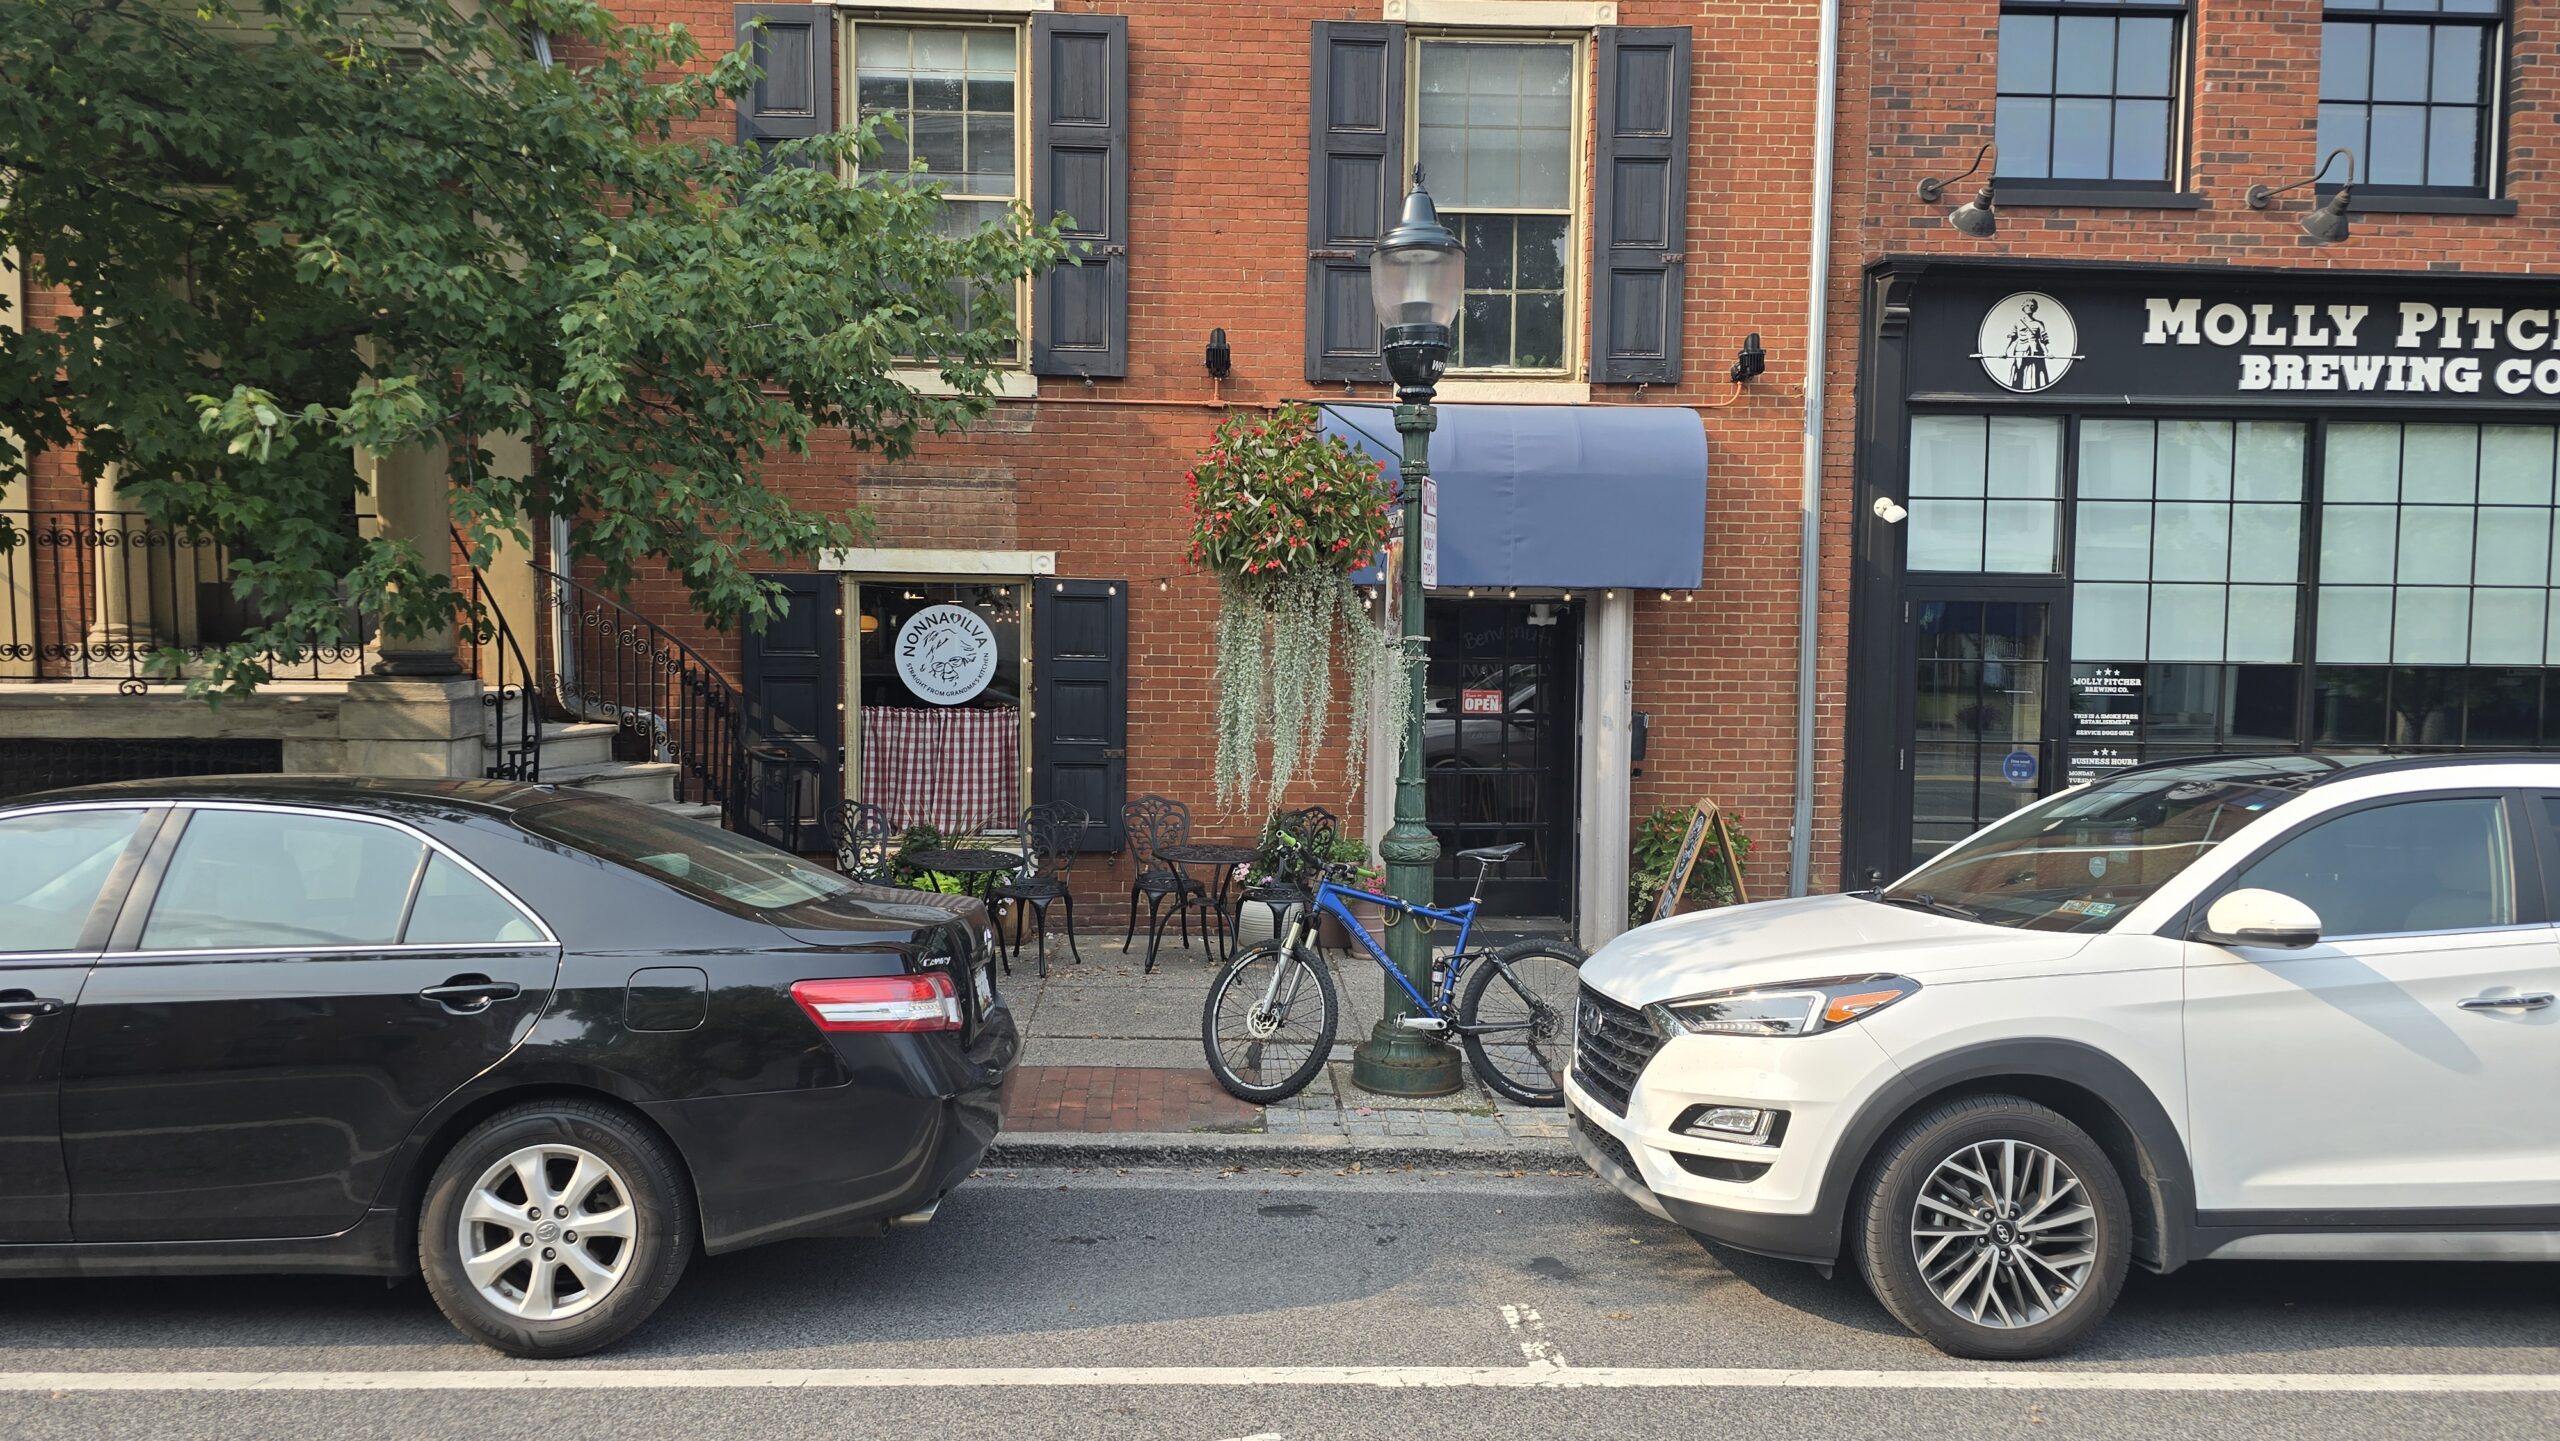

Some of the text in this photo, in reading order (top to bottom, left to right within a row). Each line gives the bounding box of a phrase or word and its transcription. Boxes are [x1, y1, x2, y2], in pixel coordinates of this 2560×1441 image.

[2142, 298, 2560, 352] MOLLY PITC
[2238, 354, 2482, 393] BREWING
[903, 611, 988, 657] NONNA ILVA
[1463, 625, 1553, 650] Benvnuti
[906, 652, 989, 697] STRAIGHT FROM GRANDMA'S KITCHEN
[2103, 678, 2142, 686] PITCHER
[1464, 697, 1499, 711] OPEN
